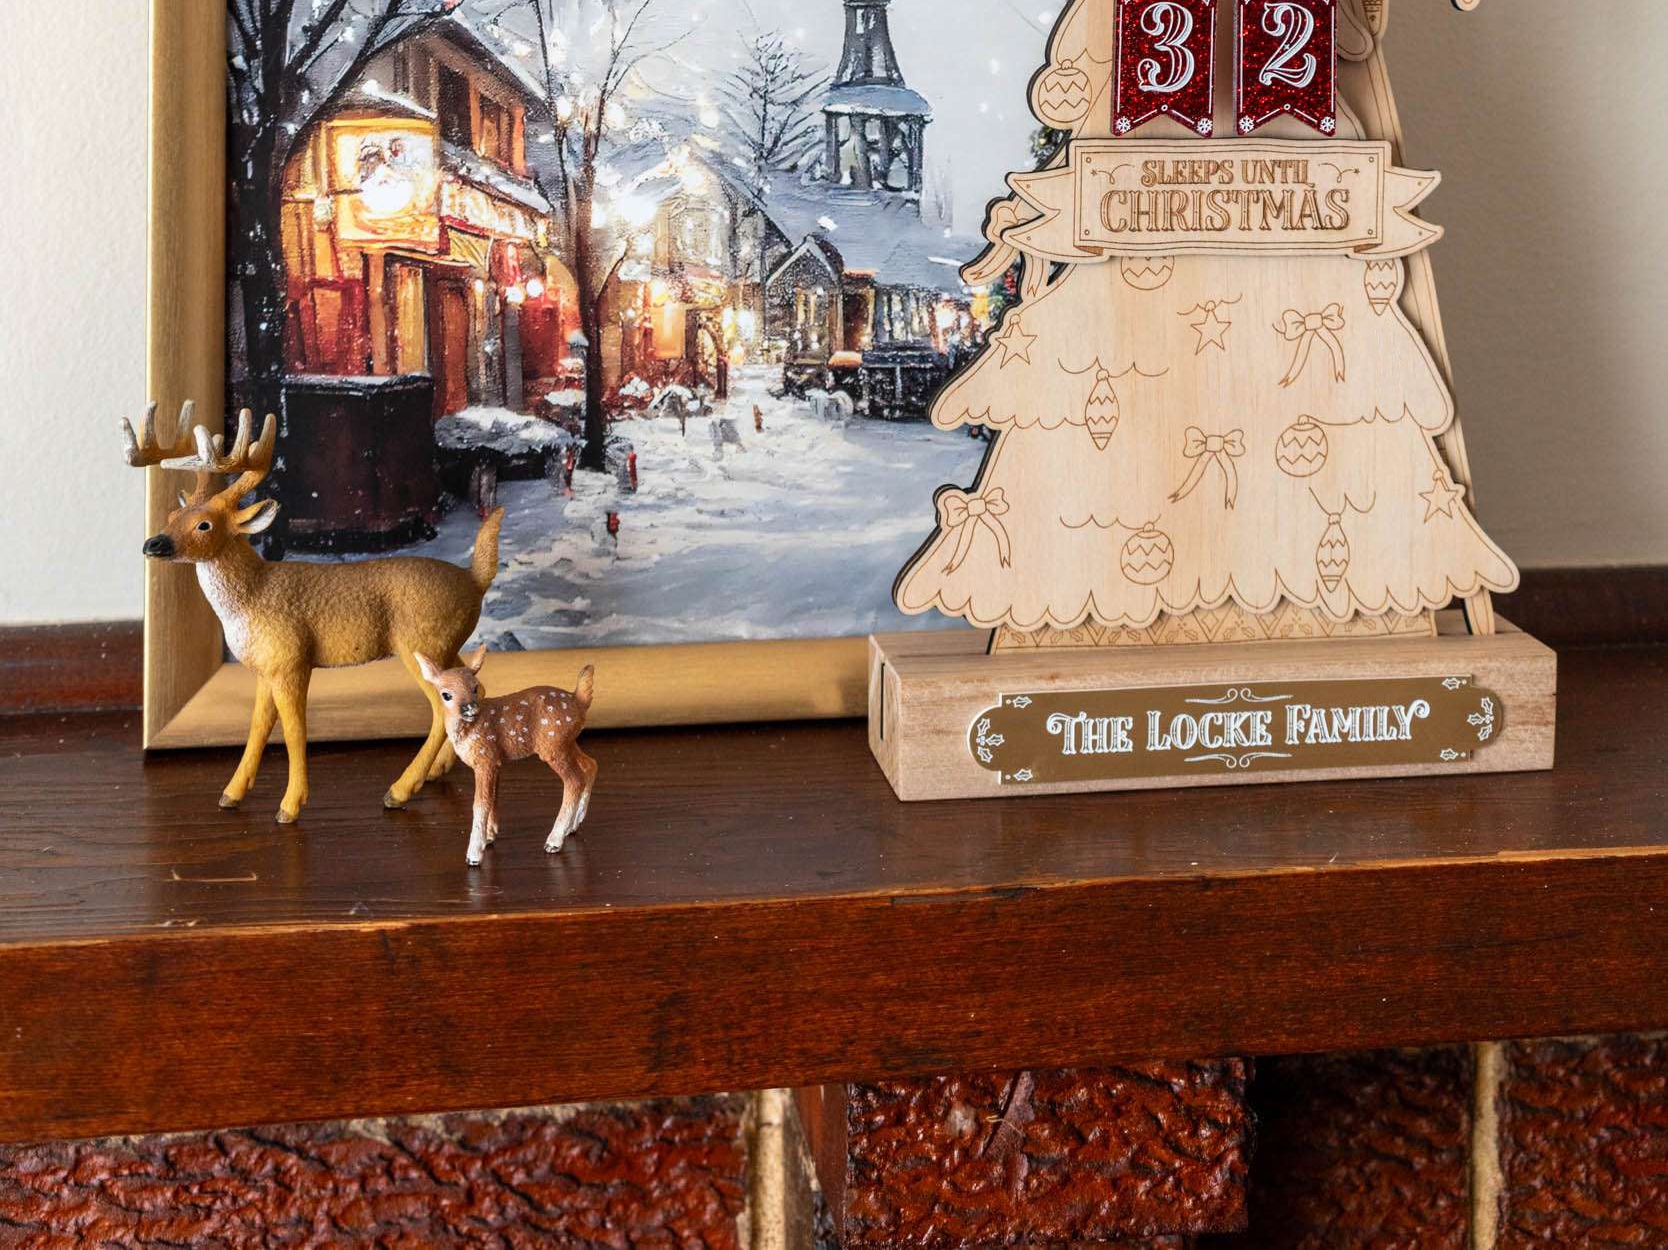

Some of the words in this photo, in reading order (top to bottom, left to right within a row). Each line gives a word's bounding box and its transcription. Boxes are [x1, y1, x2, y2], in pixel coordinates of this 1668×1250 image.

[1137, 1, 1195, 92] 3
[1258, 2, 1317, 88] 2
[1141, 159, 1233, 185] SLEEPS
[1241, 159, 1315, 188] UNTIL
[1100, 188, 1350, 233] CHRISTMAS
[1046, 711, 1133, 754] THE
[1146, 710, 1273, 751] LOCKE
[1284, 699, 1430, 744] FAMILY
